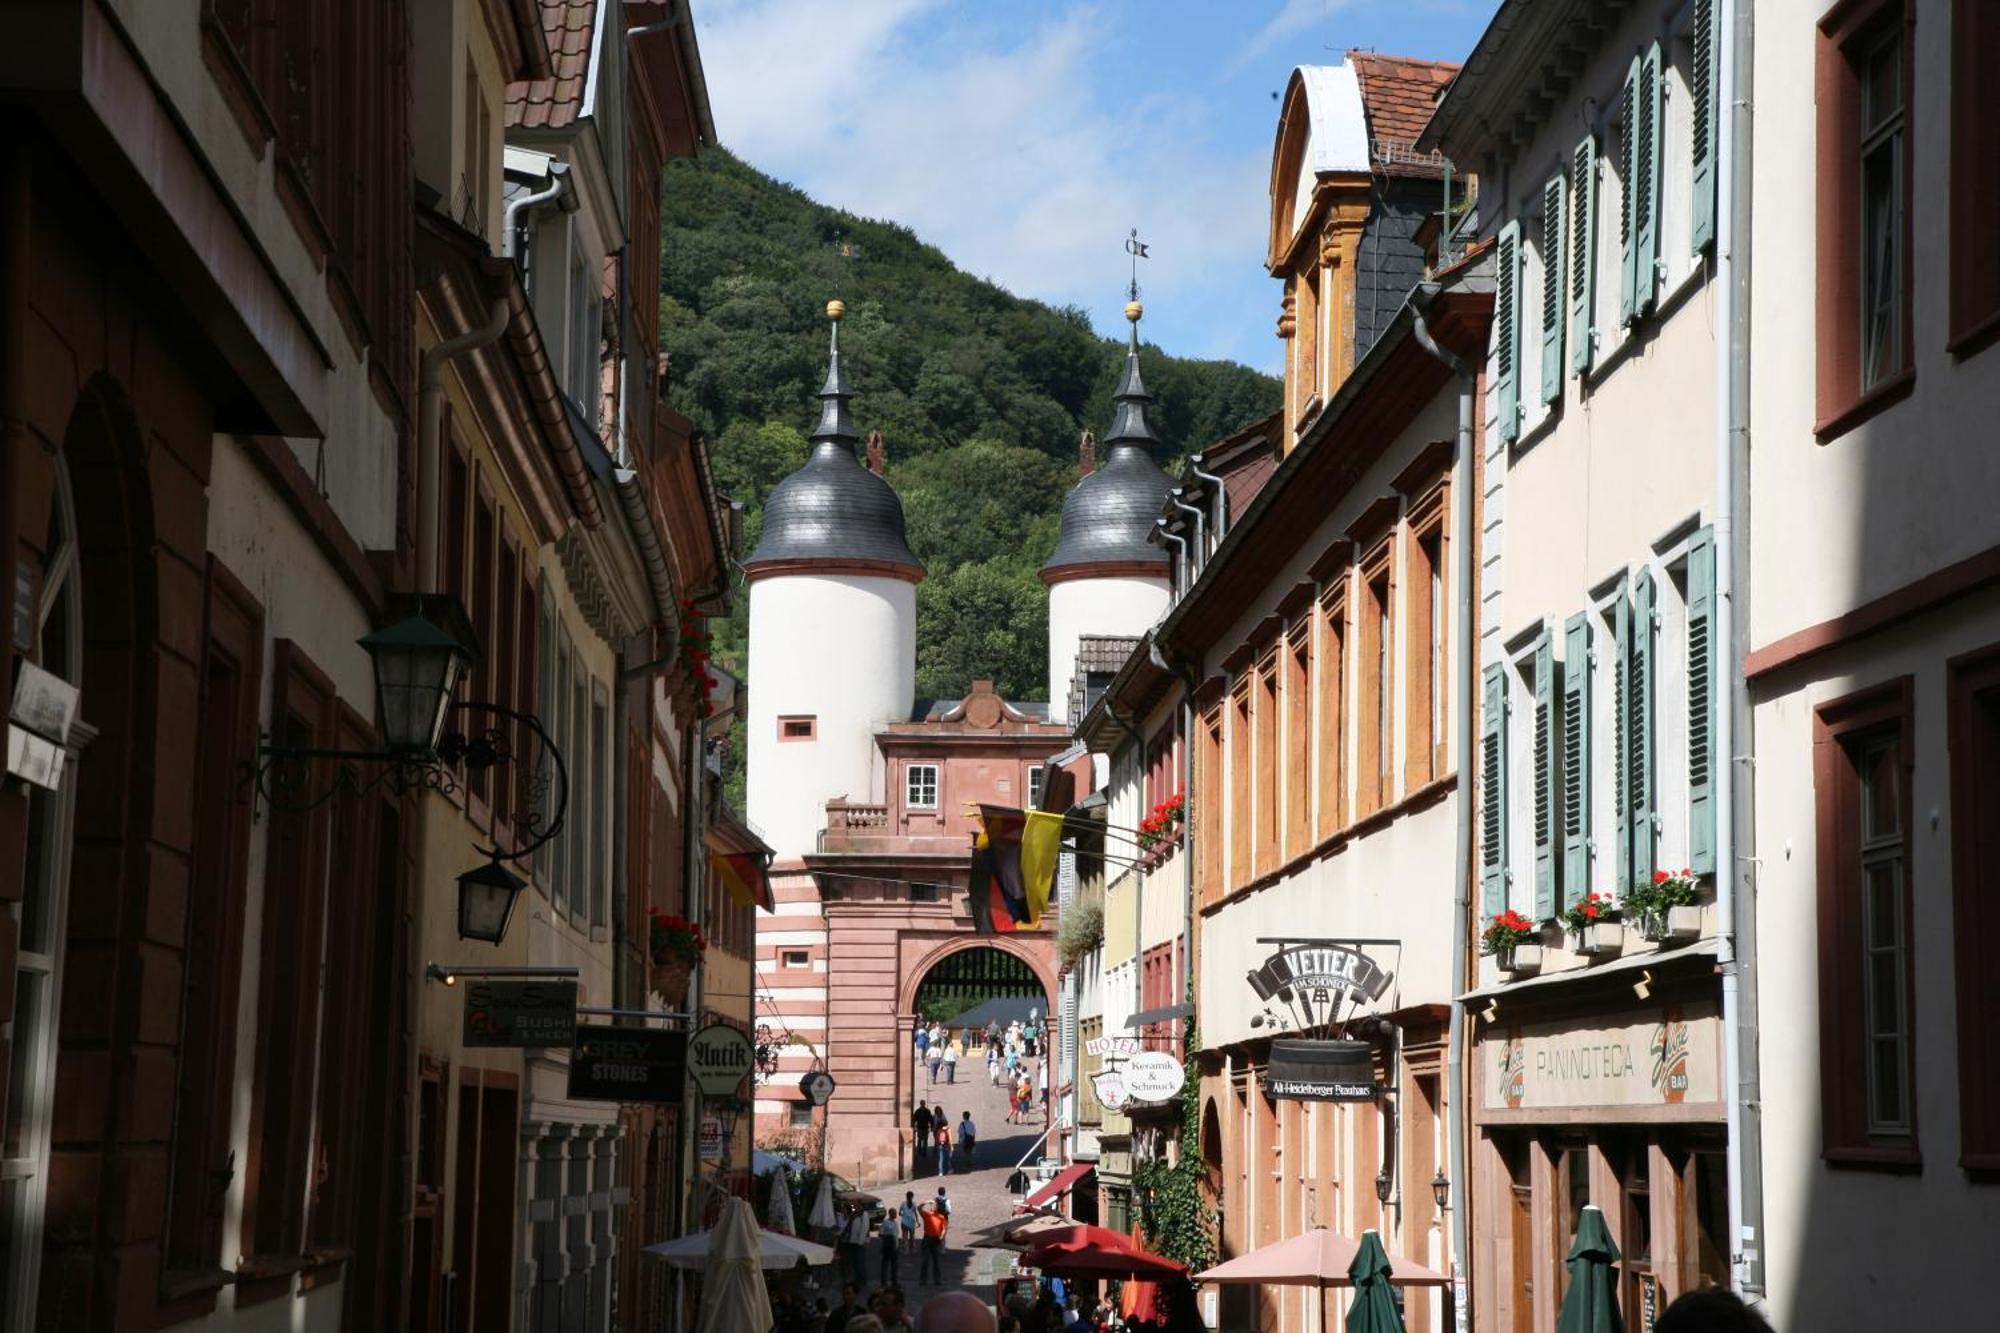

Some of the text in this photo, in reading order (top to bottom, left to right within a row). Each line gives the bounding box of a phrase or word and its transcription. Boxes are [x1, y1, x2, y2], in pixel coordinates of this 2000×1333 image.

[1283, 949, 1358, 981] VETTER
[1088, 1038, 1136, 1055] HOTEL
[694, 1041, 748, 1067] Antik
[1132, 1061, 1173, 1071] Keramik
[1537, 1045, 1634, 1080] PANINOTECA
[1148, 1072, 1156, 1080] &
[1671, 1076, 1686, 1089] BAR
[1131, 1081, 1176, 1091] Schmuck
[1335, 1084, 1370, 1096] Brauhaus
